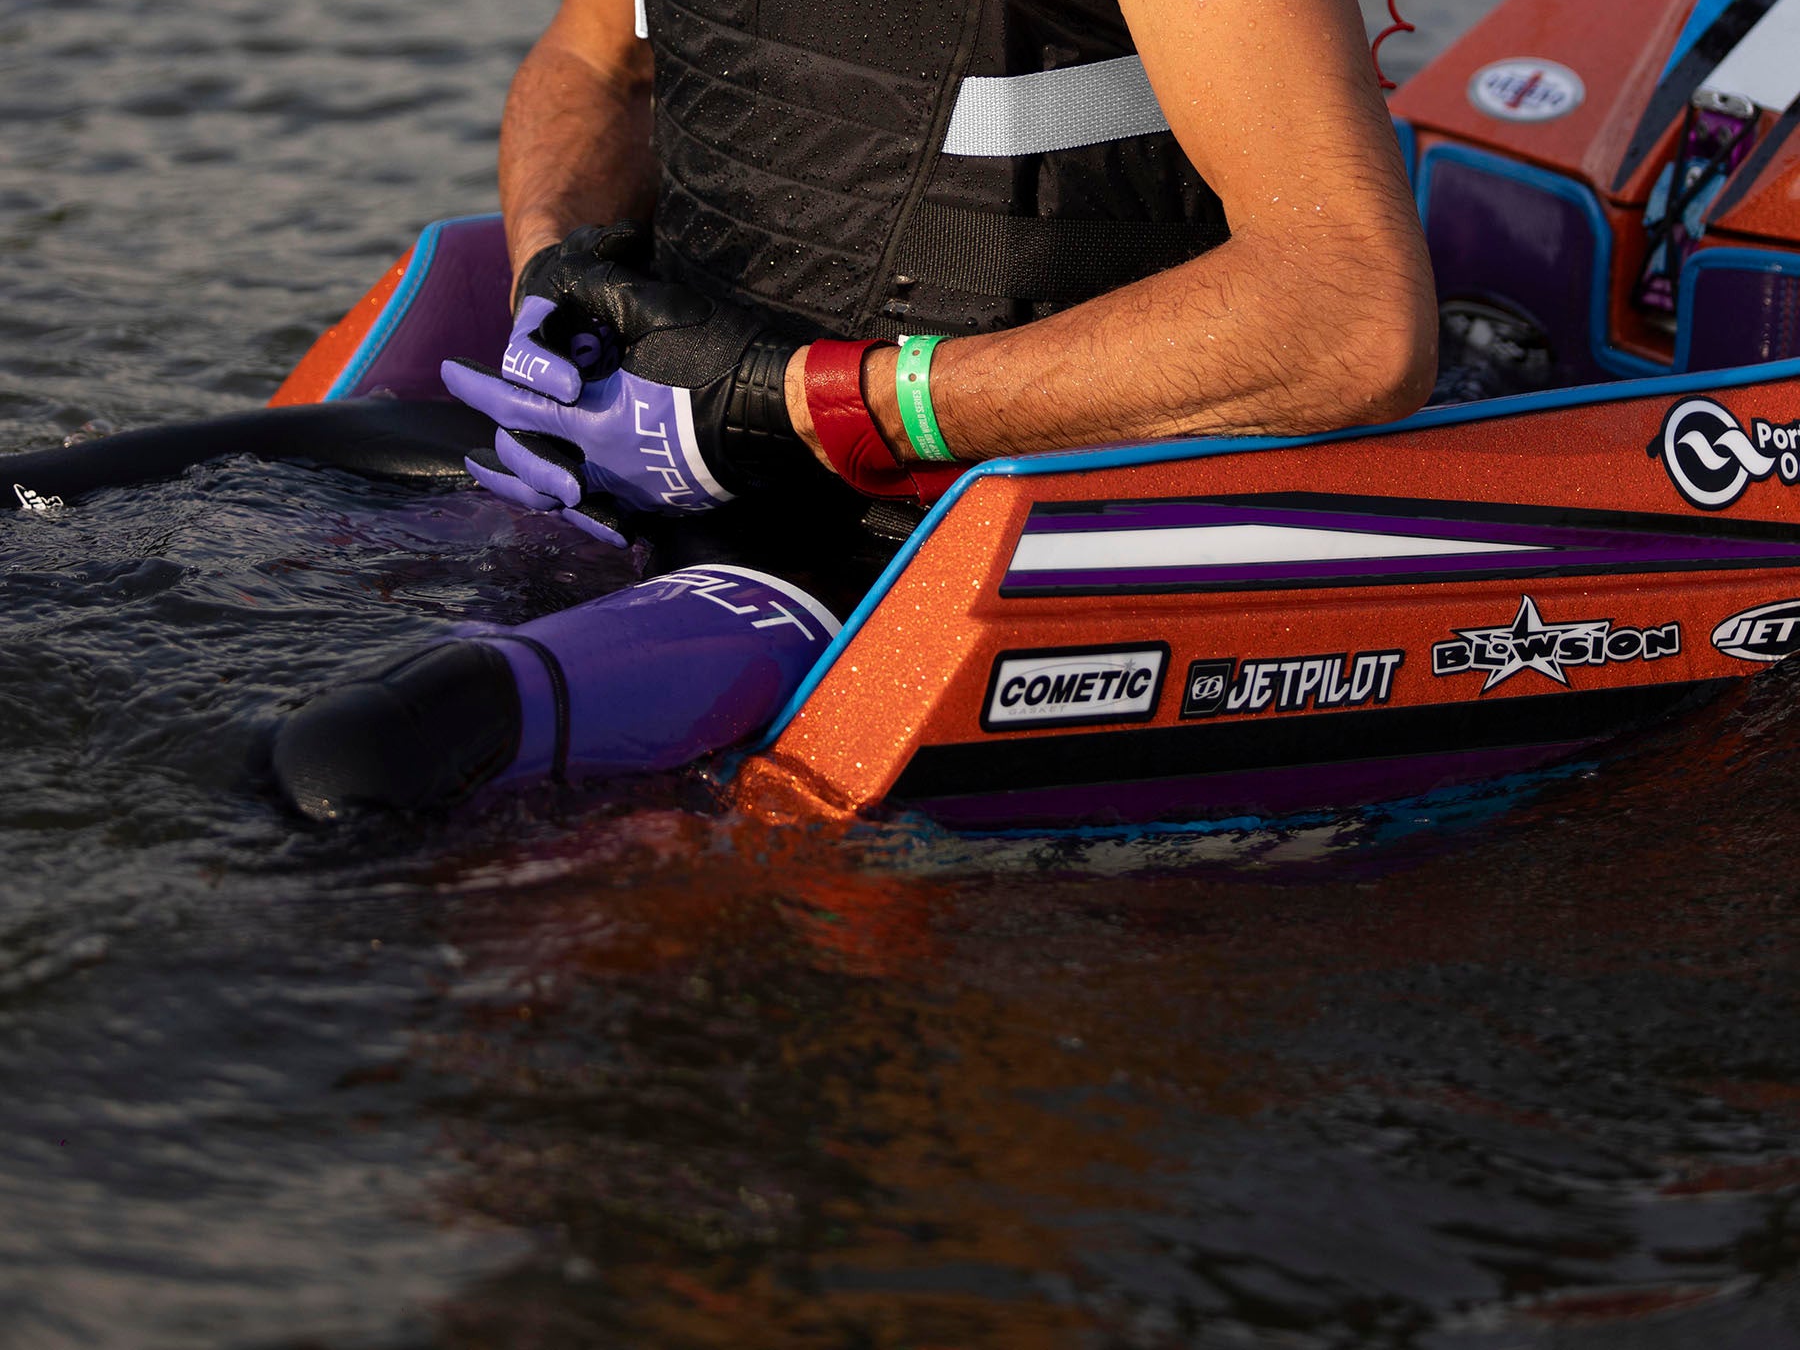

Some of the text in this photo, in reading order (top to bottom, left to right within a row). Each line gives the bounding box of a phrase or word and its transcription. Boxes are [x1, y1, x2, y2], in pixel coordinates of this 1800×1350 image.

[911, 389, 925, 413] SERIES
[917, 413, 931, 433] WORLD
[1756, 422, 1800, 450] Por
[1780, 451, 1800, 480] O
[1000, 668, 1152, 707] COMETIC
[1226, 654, 1401, 710] JETPILOT
[1008, 705, 1067, 716] GASKET
